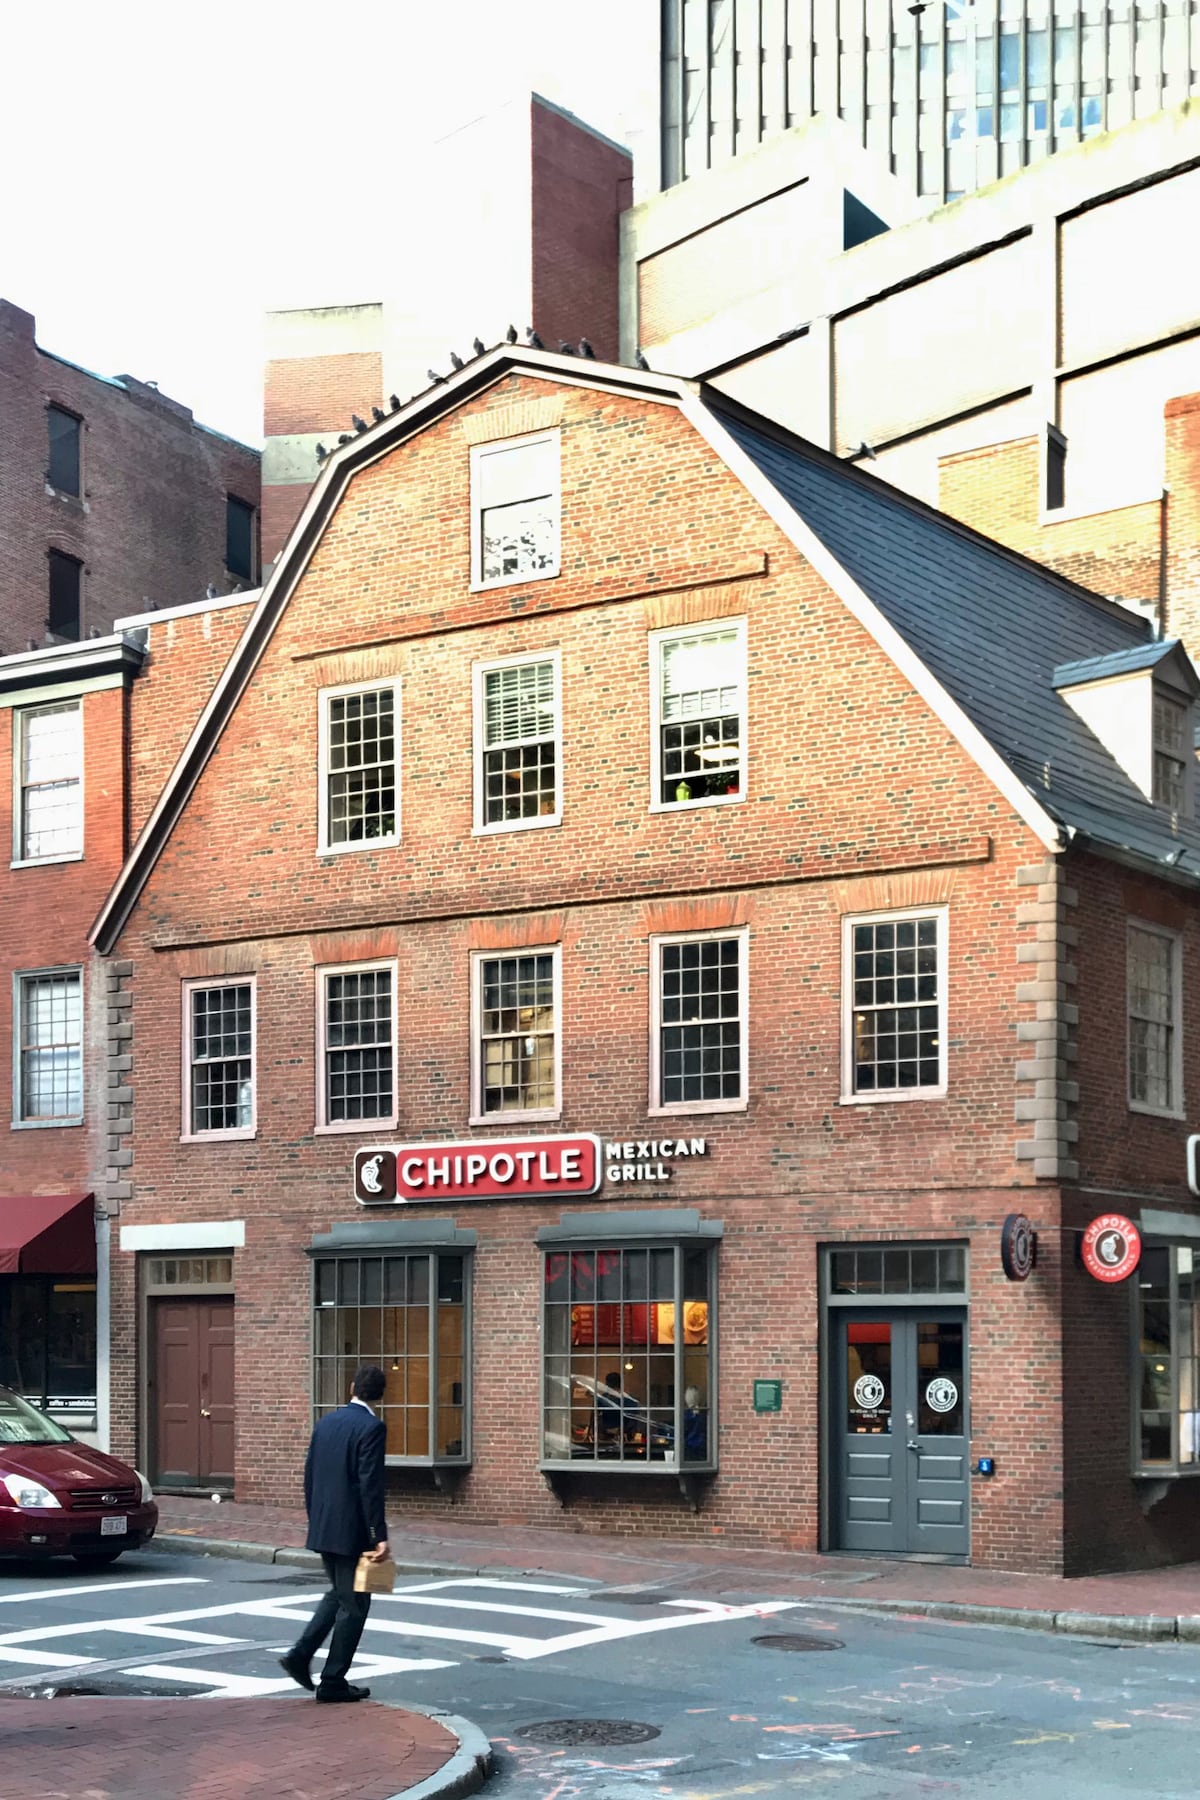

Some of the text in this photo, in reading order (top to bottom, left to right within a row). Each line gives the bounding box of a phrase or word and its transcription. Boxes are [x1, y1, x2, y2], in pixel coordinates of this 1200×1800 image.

[606, 1138, 706, 1160] MEXICAN
[401, 1148, 582, 1187] CHIPOTLE
[606, 1163, 670, 1181] GRILL
[1085, 1217, 1137, 1243] CHIPOTLE
